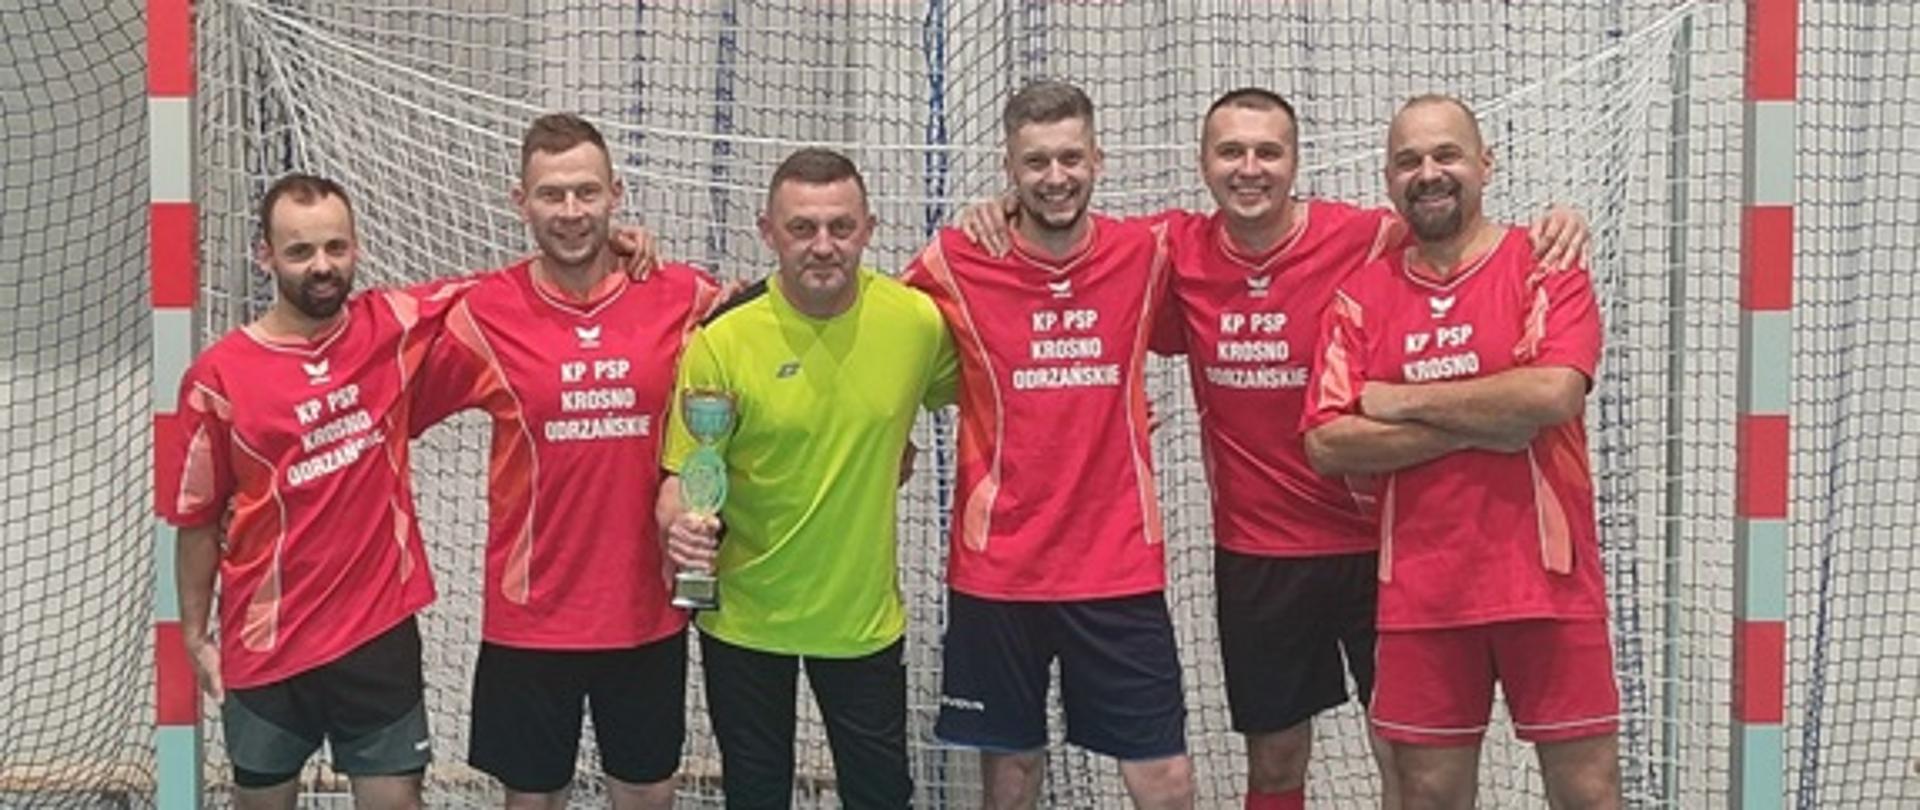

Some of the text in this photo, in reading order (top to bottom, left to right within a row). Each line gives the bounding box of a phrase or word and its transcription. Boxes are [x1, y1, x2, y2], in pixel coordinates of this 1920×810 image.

[1032, 309, 1098, 332] KP PSP
[1220, 313, 1287, 335] KP PSP
[1031, 337, 1102, 360] KROSNO
[1217, 341, 1289, 362] KROSNO
[1404, 323, 1473, 354] KP PSP
[561, 359, 630, 383] KP PSP
[1013, 361, 1120, 390] ODRZAŃSKIE
[1404, 352, 1479, 382] KROSNO
[294, 384, 359, 425] KP PSP
[561, 387, 636, 412] KROSNO
[302, 410, 372, 453] KROSNO
[545, 412, 650, 442] ODRZAŃSKIE
